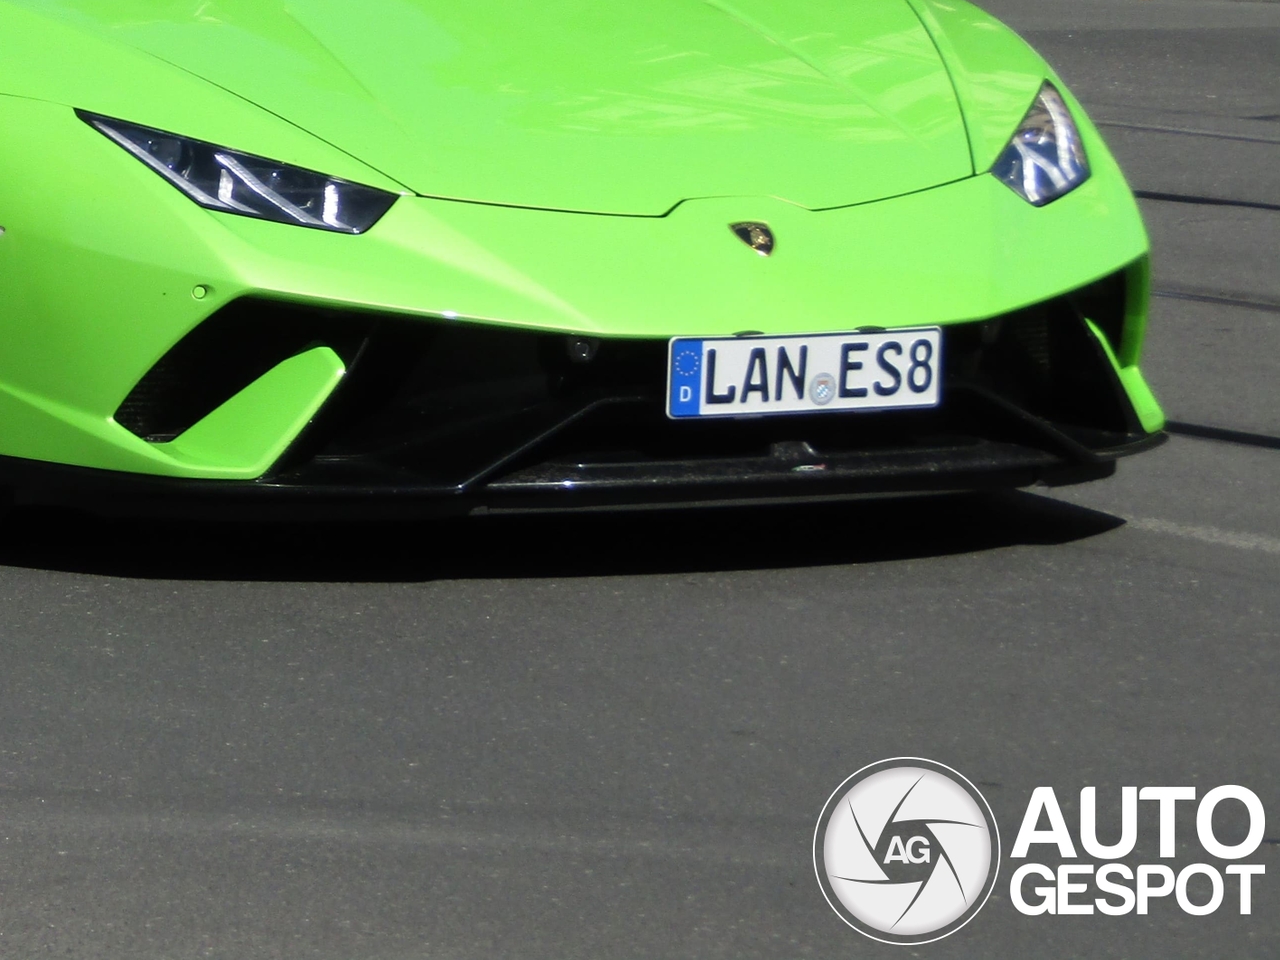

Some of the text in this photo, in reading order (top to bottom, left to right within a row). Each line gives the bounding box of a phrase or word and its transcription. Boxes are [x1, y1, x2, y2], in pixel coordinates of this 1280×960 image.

[706, 339, 933, 404] LAN ES8
[679, 386, 692, 402] D
